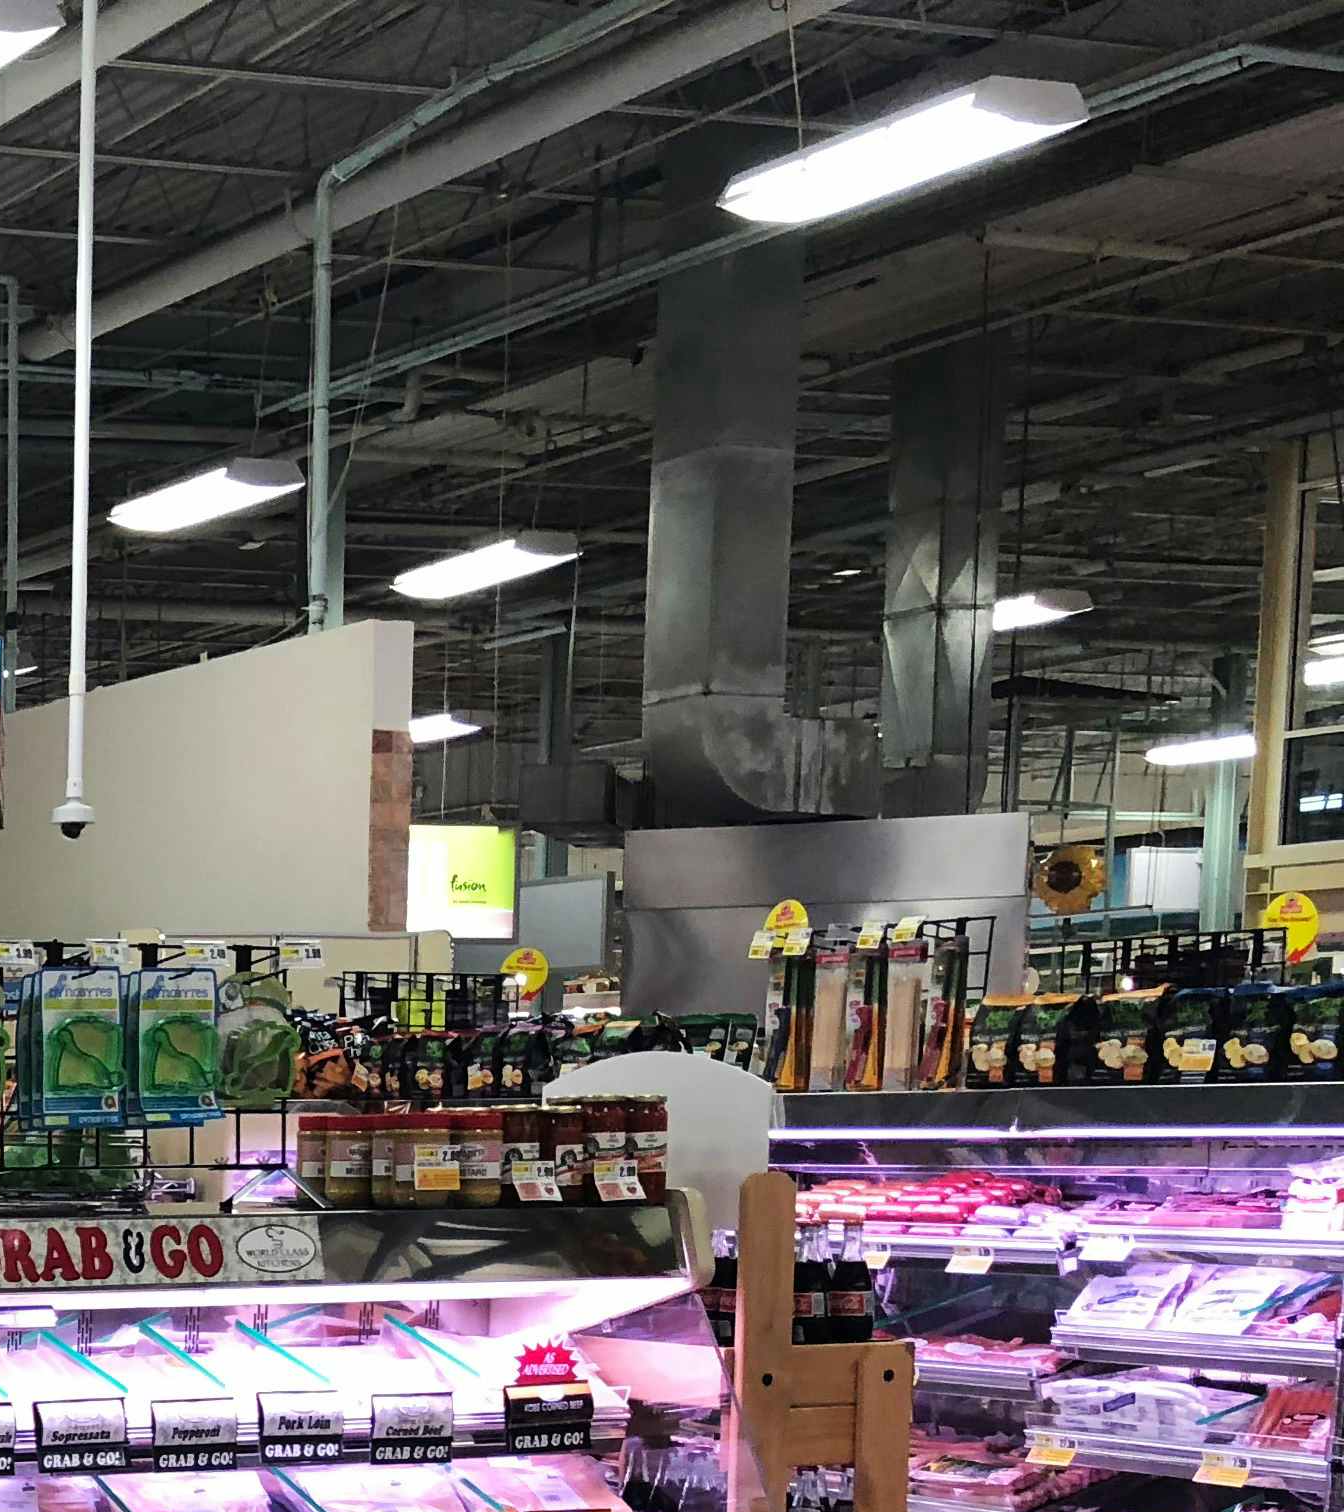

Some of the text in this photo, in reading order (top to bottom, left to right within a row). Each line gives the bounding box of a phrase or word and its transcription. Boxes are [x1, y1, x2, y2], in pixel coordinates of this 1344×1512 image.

[451, 874, 486, 892] fusion
[122, 1228, 144, 1273] &
[150, 1224, 224, 1279] GO
[257, 1259, 302, 1268] KITCHENS
[278, 1416, 331, 1431] Pork Loin
[51, 1429, 110, 1443] Sopressata
